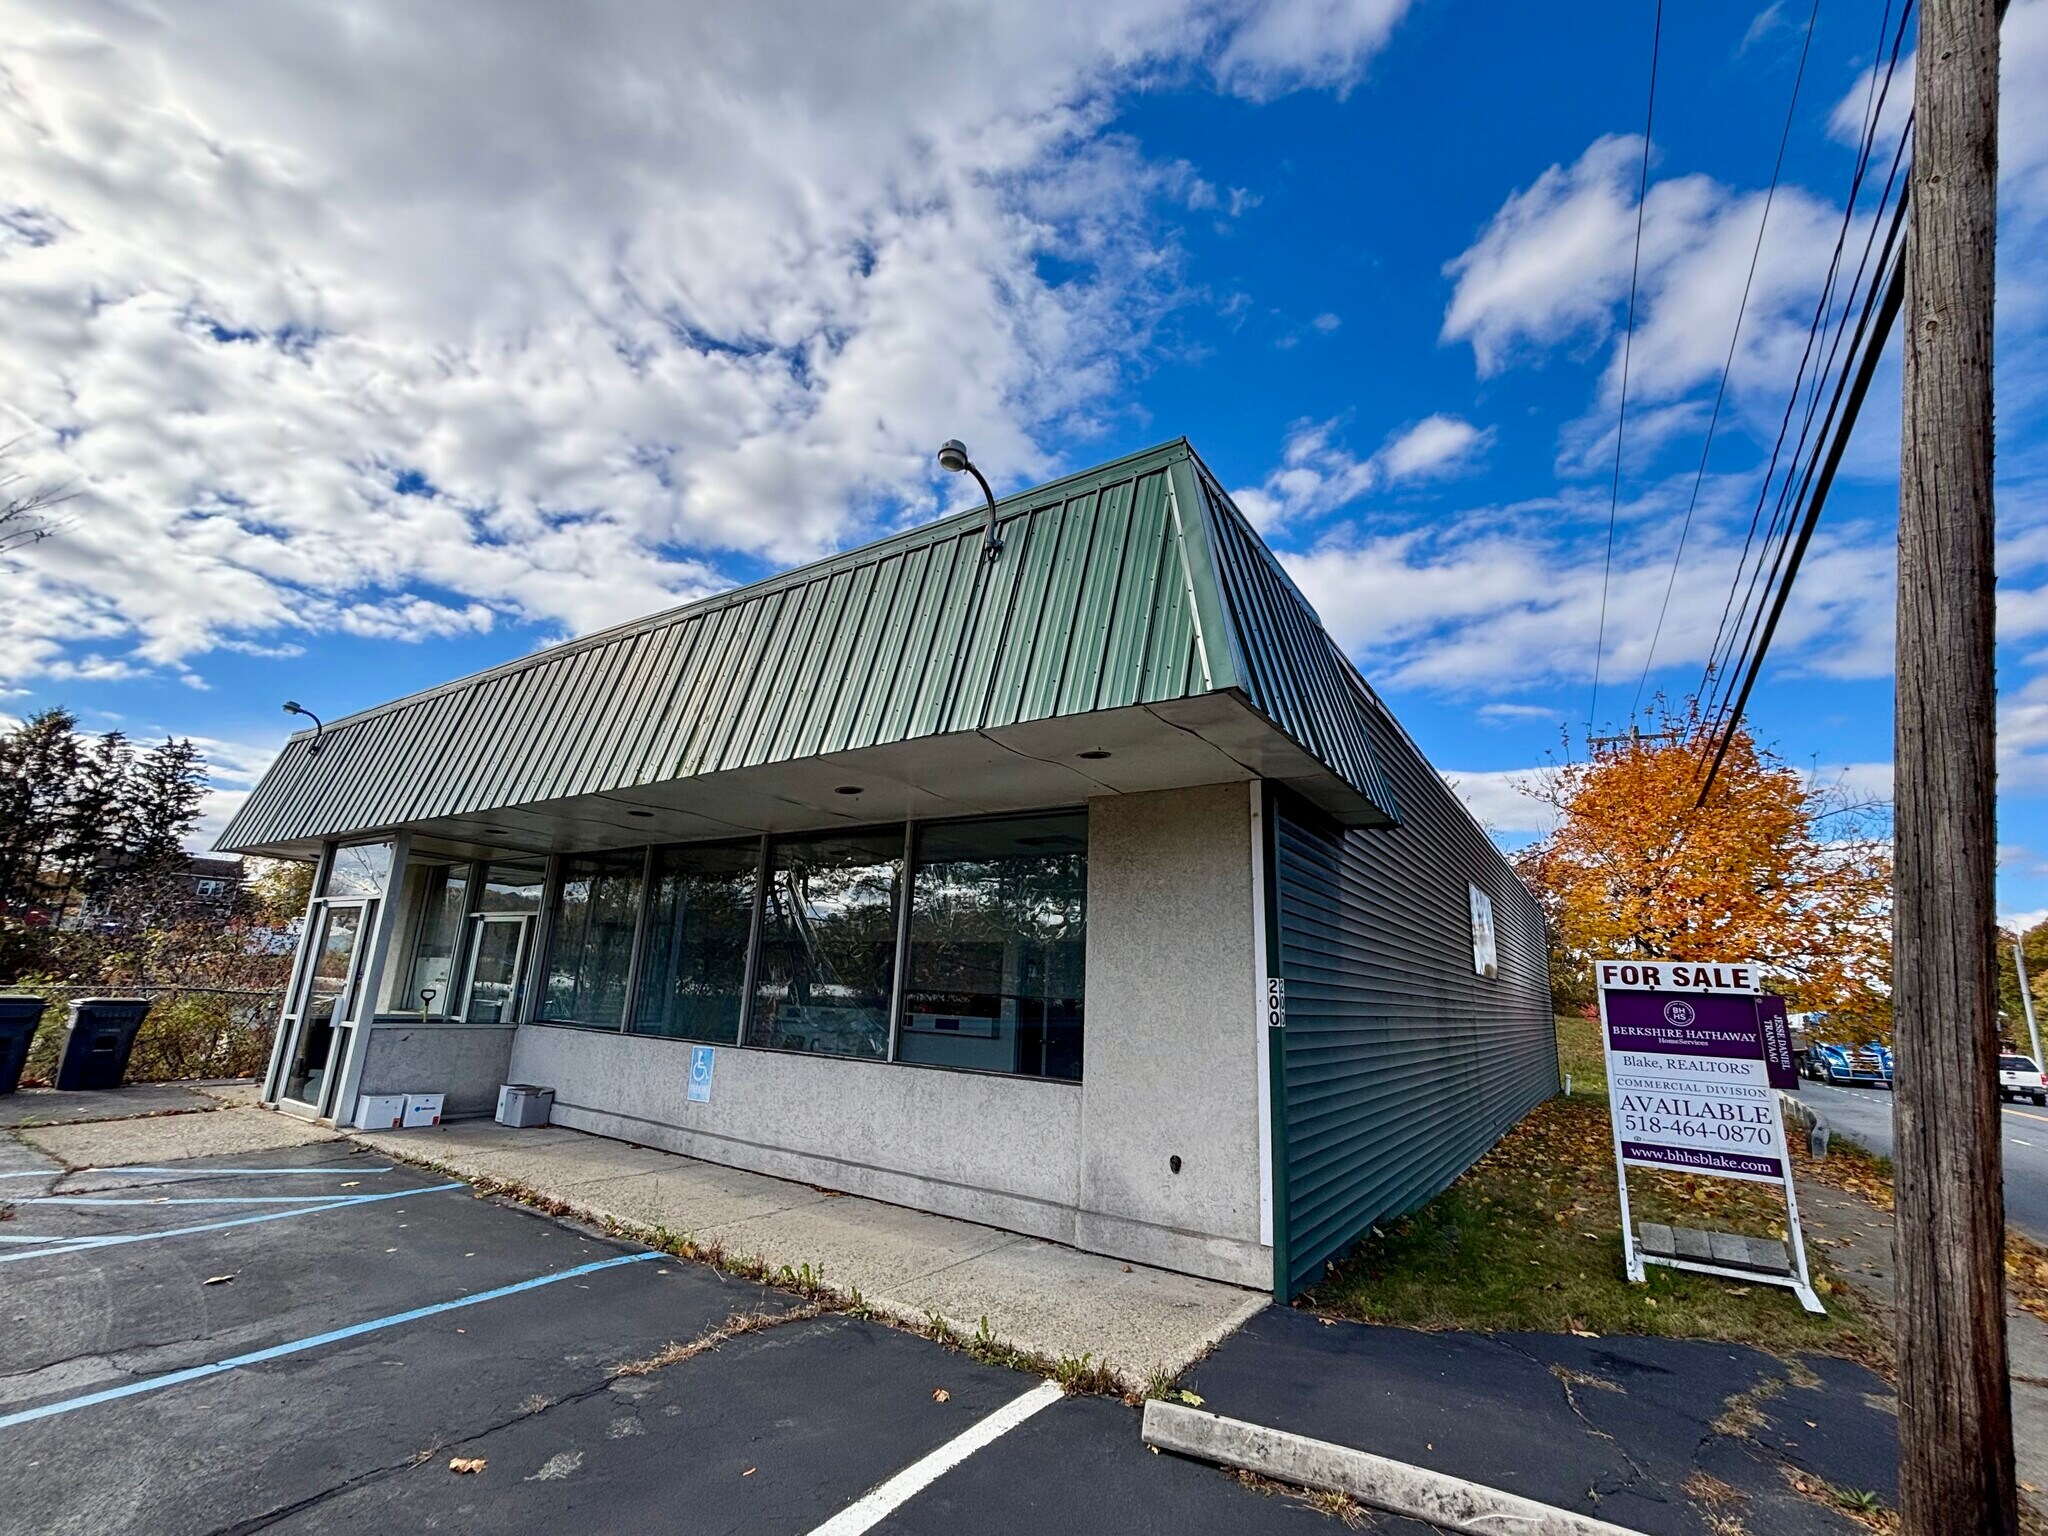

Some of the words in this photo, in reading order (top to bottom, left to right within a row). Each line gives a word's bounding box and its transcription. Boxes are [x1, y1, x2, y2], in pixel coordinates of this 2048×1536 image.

[1602, 965, 1661, 986] FOR
[1672, 966, 1751, 989] SALE
[1612, 1026, 1683, 1038] BERKSHIRE
[1686, 1030, 1757, 1043] HATHAWAY
[1773, 1014, 1786, 1039] JESSE
[1658, 1037, 1709, 1046] HomeServices
[1763, 1019, 1779, 1063] TRANVAAG
[1623, 1055, 1663, 1070] Blake,
[1778, 1039, 1791, 1071] DANIEL
[1617, 1078, 1701, 1093] COMMERCIAL
[1706, 1085, 1767, 1098] DIVISION
[1619, 1094, 1773, 1125] AVAILABLE
[1625, 1114, 1772, 1146] 518-464-0870
[1630, 1147, 1772, 1173] www.bhhsblake.com
